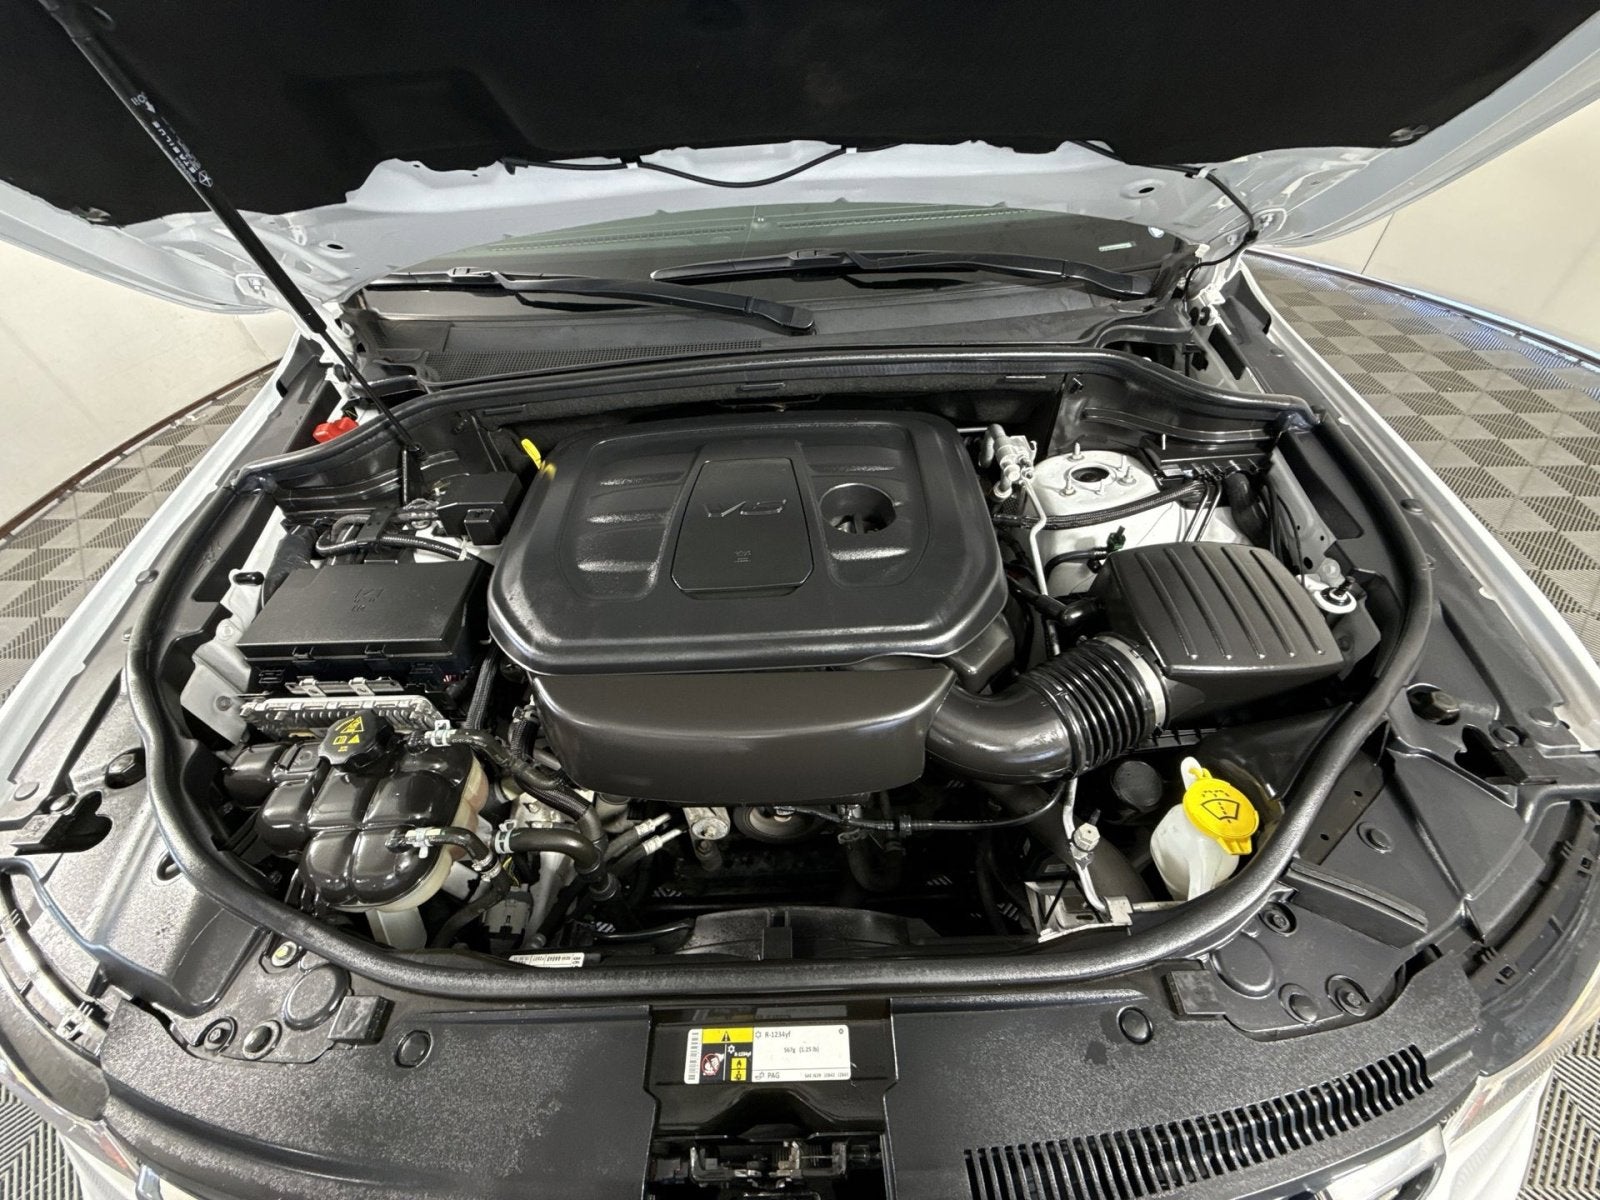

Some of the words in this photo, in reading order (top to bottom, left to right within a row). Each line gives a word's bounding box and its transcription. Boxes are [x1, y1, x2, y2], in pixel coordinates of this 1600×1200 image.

[152, 121, 197, 173] STABILUS
[702, 498, 787, 518] V6
[764, 1030, 791, 1039] R-1234yf
[767, 1071, 780, 1079] PAG
